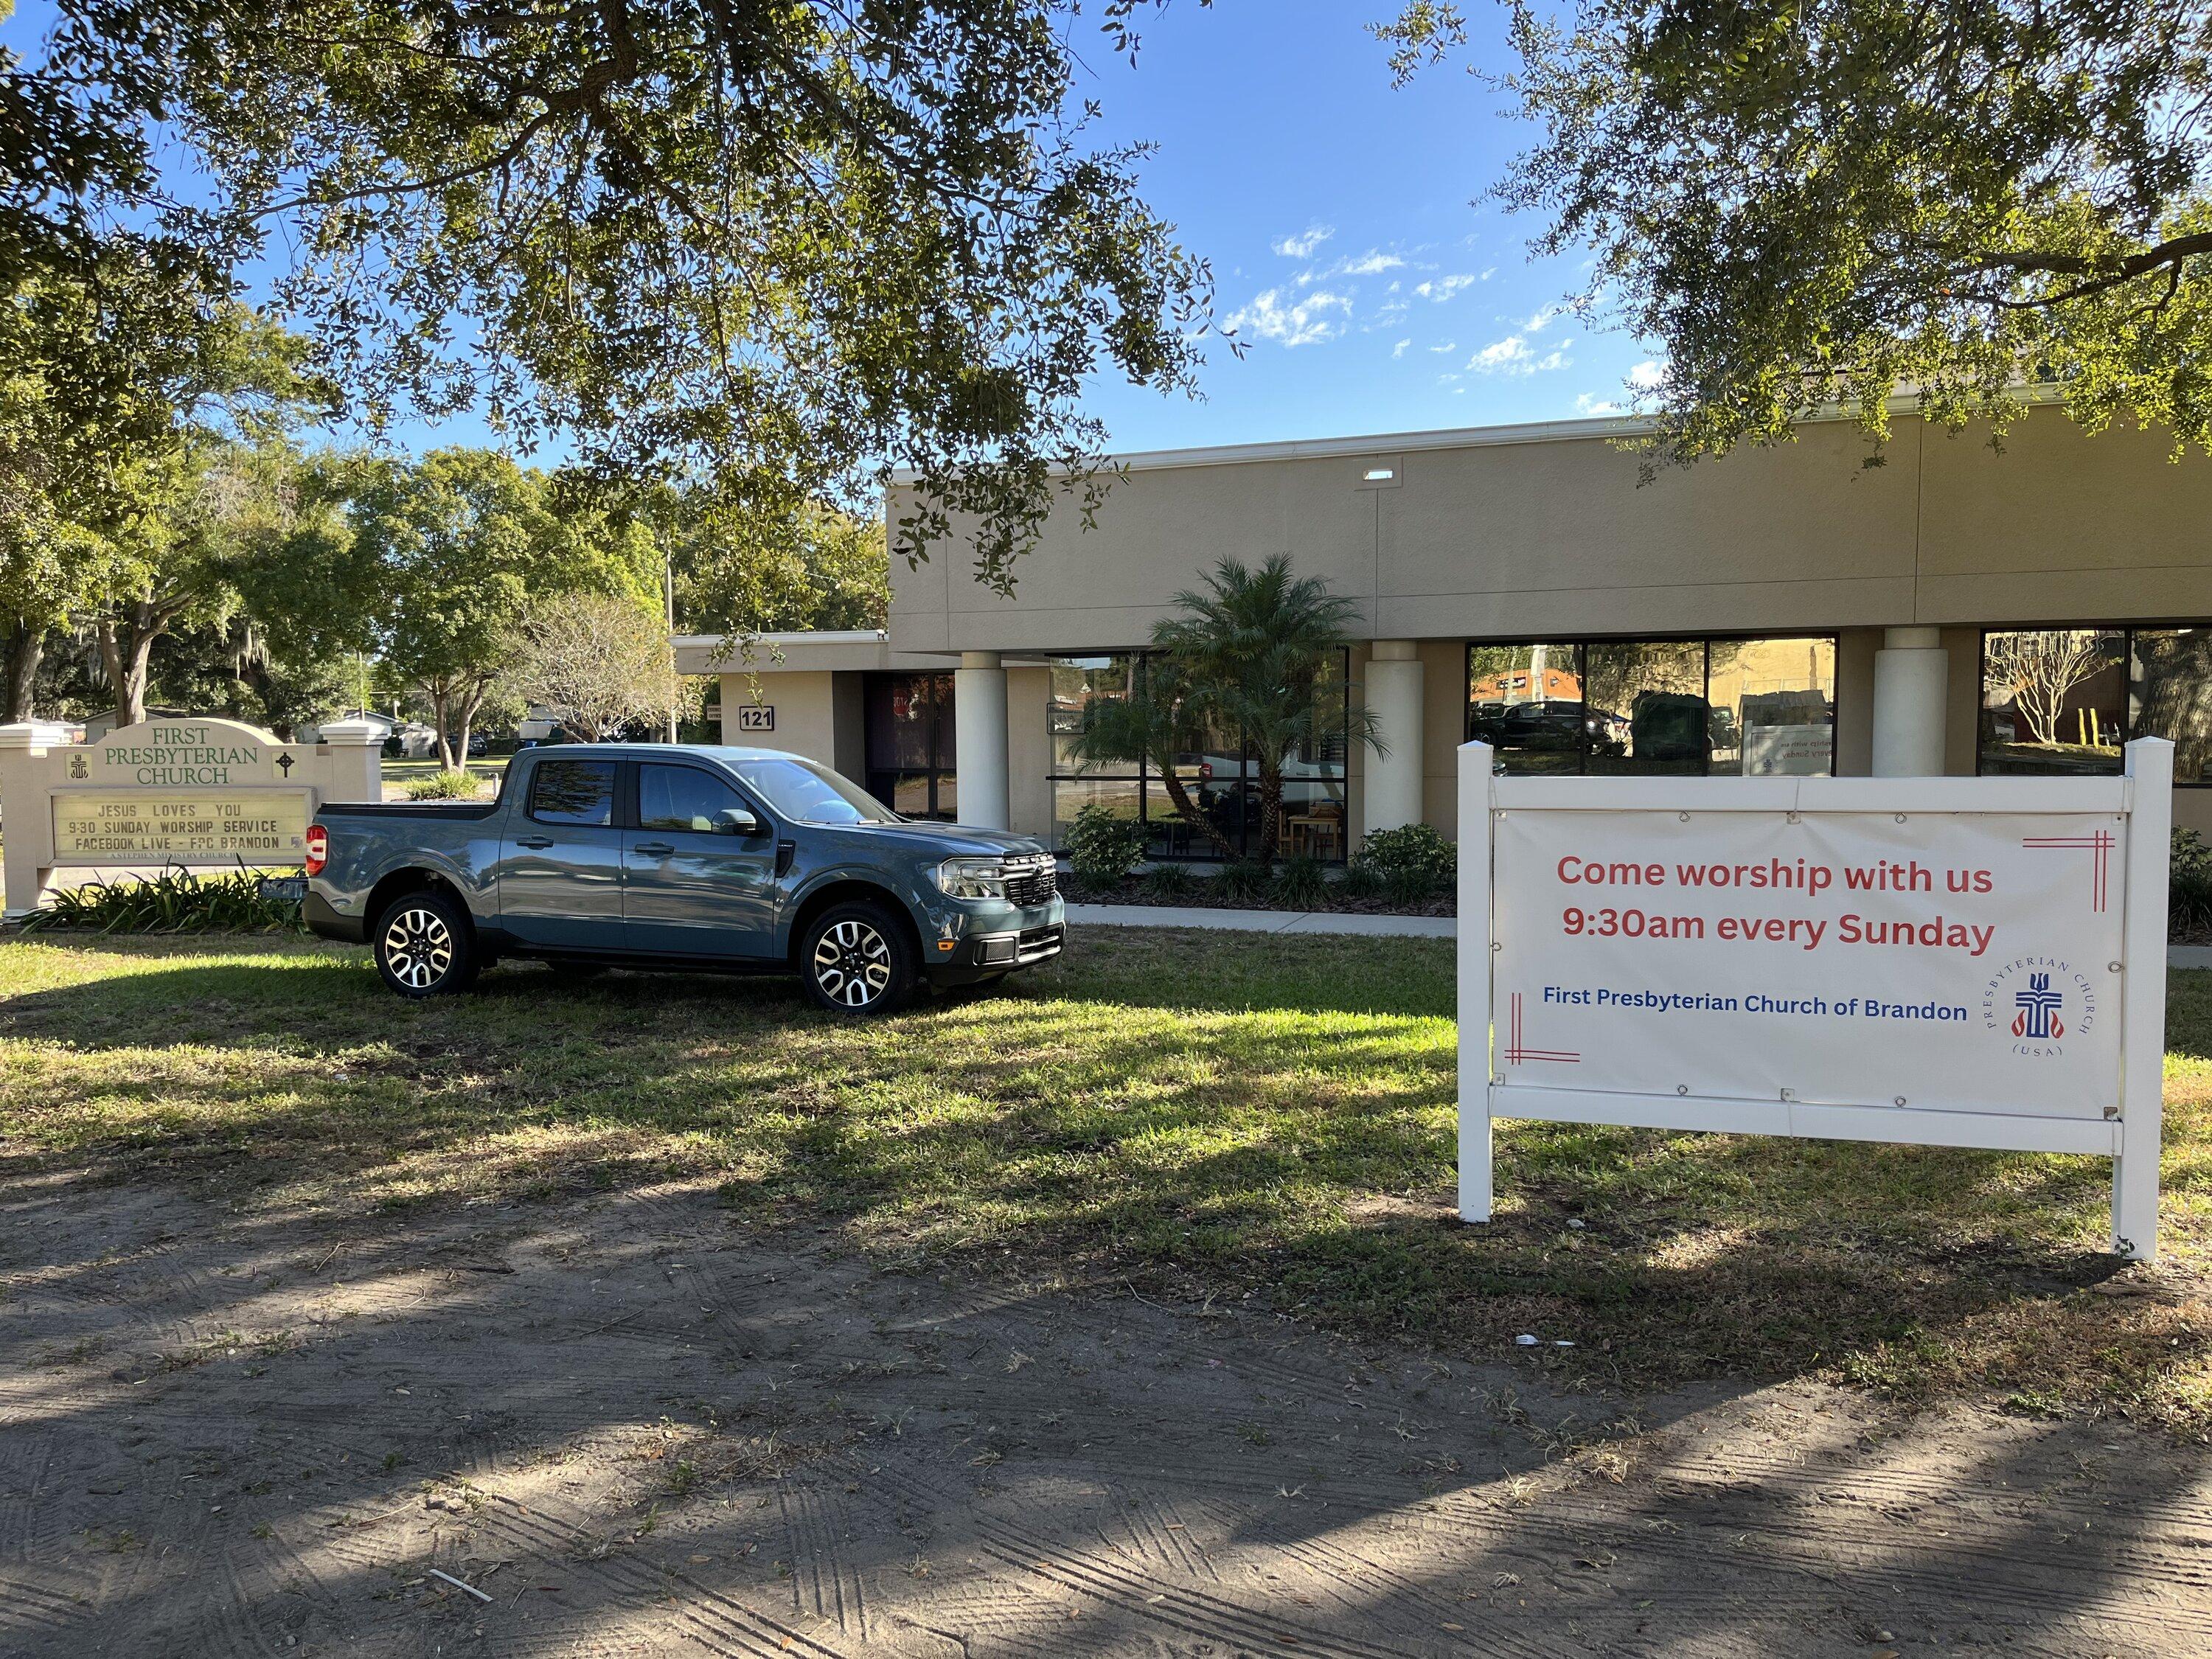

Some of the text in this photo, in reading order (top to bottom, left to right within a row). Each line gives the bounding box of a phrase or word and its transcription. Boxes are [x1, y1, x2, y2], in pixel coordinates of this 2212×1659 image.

[742, 711, 771, 726] 121
[152, 727, 209, 745] FIRST
[105, 747, 258, 765] PRESBYTERIAN
[136, 767, 229, 785] CHURCH
[98, 804, 241, 817] JESUS LOVES YOU
[69, 821, 277, 834] 9:30 SUNDAY WORSHIP SERVICE
[75, 838, 134, 849] FACEBOOK
[142, 838, 171, 849] LIVE
[190, 837, 214, 849] FPC
[221, 837, 279, 849] BRANDON
[1557, 856, 1993, 897] Come worship with us
[1562, 908, 1995, 956] 9:30am every Sunday
[1543, 987, 1968, 1021] First Presbyterian Church of Brandon
[1983, 957, 2095, 1034] PRESBYTERIAN CHURCH
[2012, 1043, 2062, 1056] (USA)
